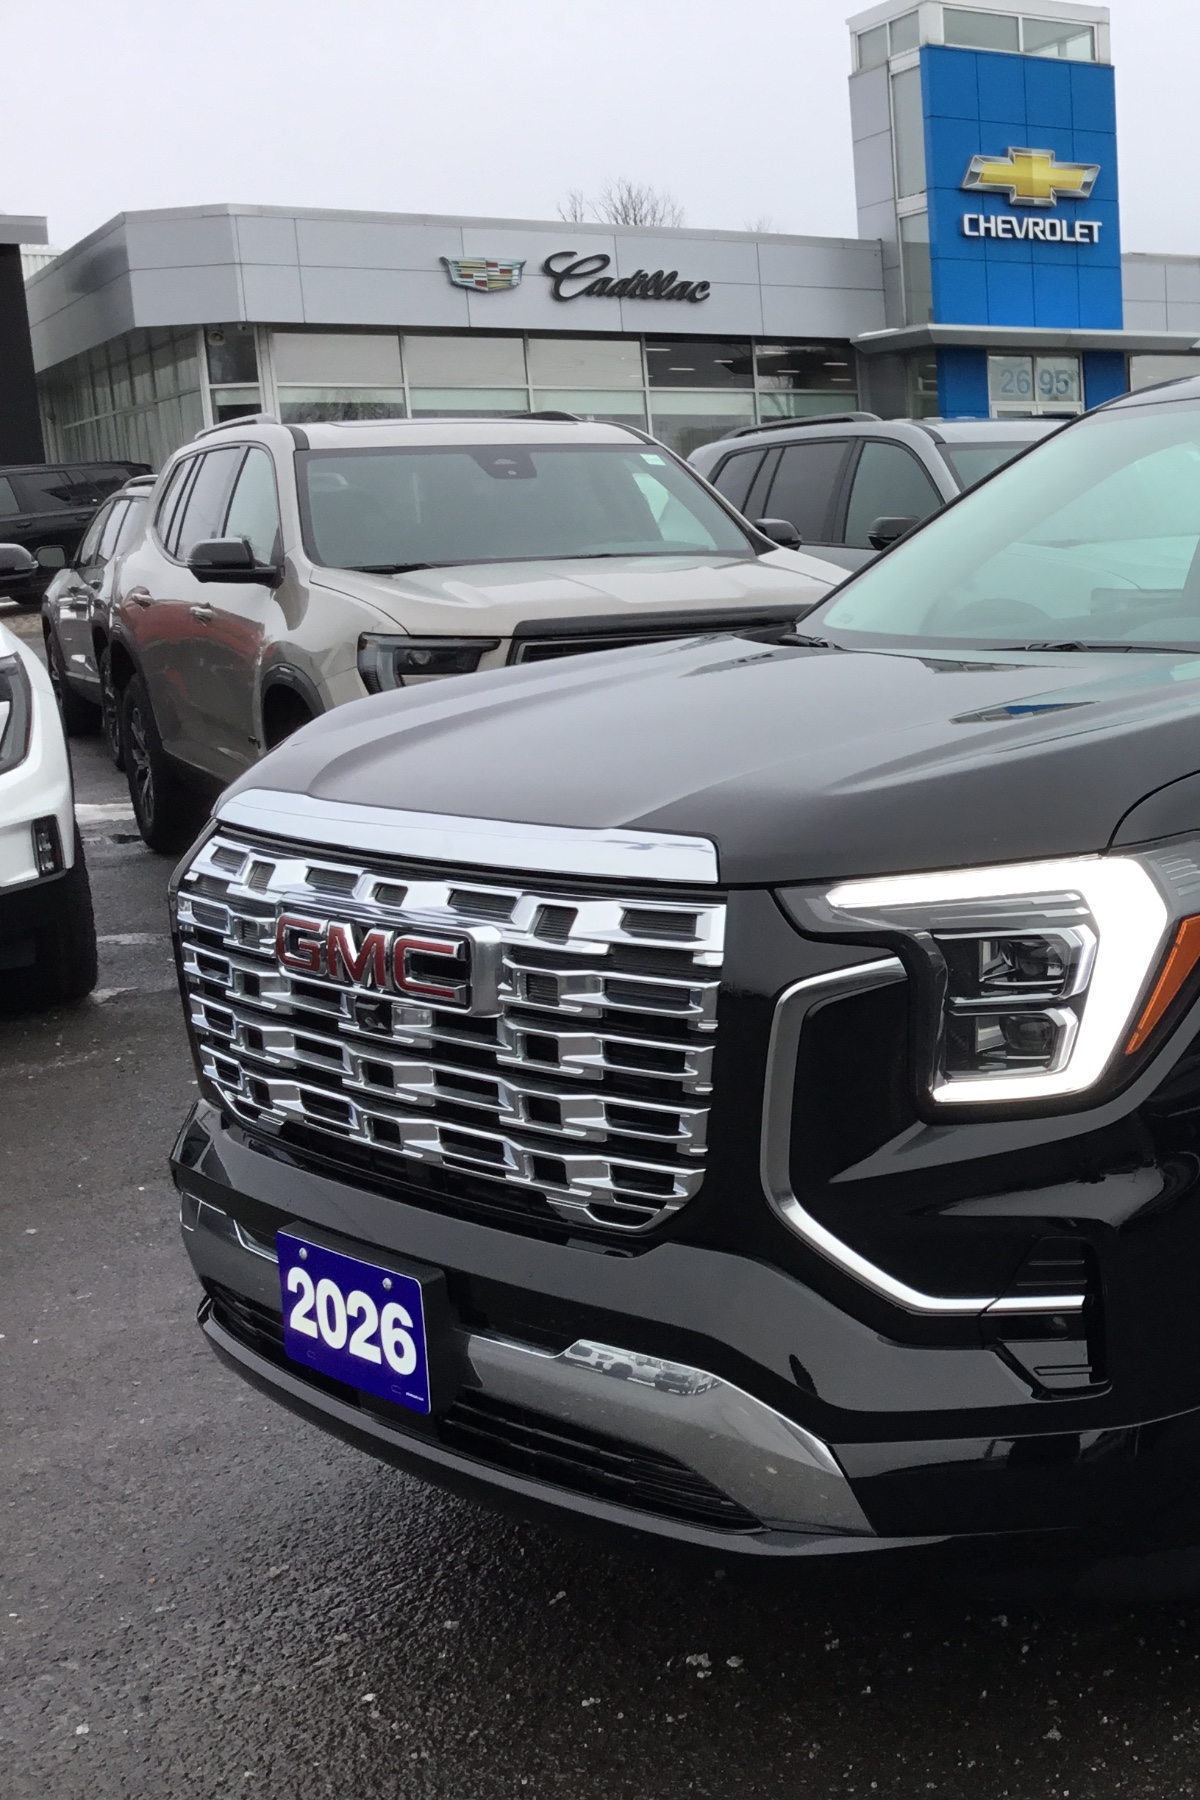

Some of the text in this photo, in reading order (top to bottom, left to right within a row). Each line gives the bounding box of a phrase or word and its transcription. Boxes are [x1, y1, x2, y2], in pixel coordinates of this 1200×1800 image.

[963, 213, 1103, 243] CHEVROLET
[542, 251, 711, 302] Cadillac
[276, 912, 467, 1004] GMC
[287, 1266, 418, 1376] 2026
